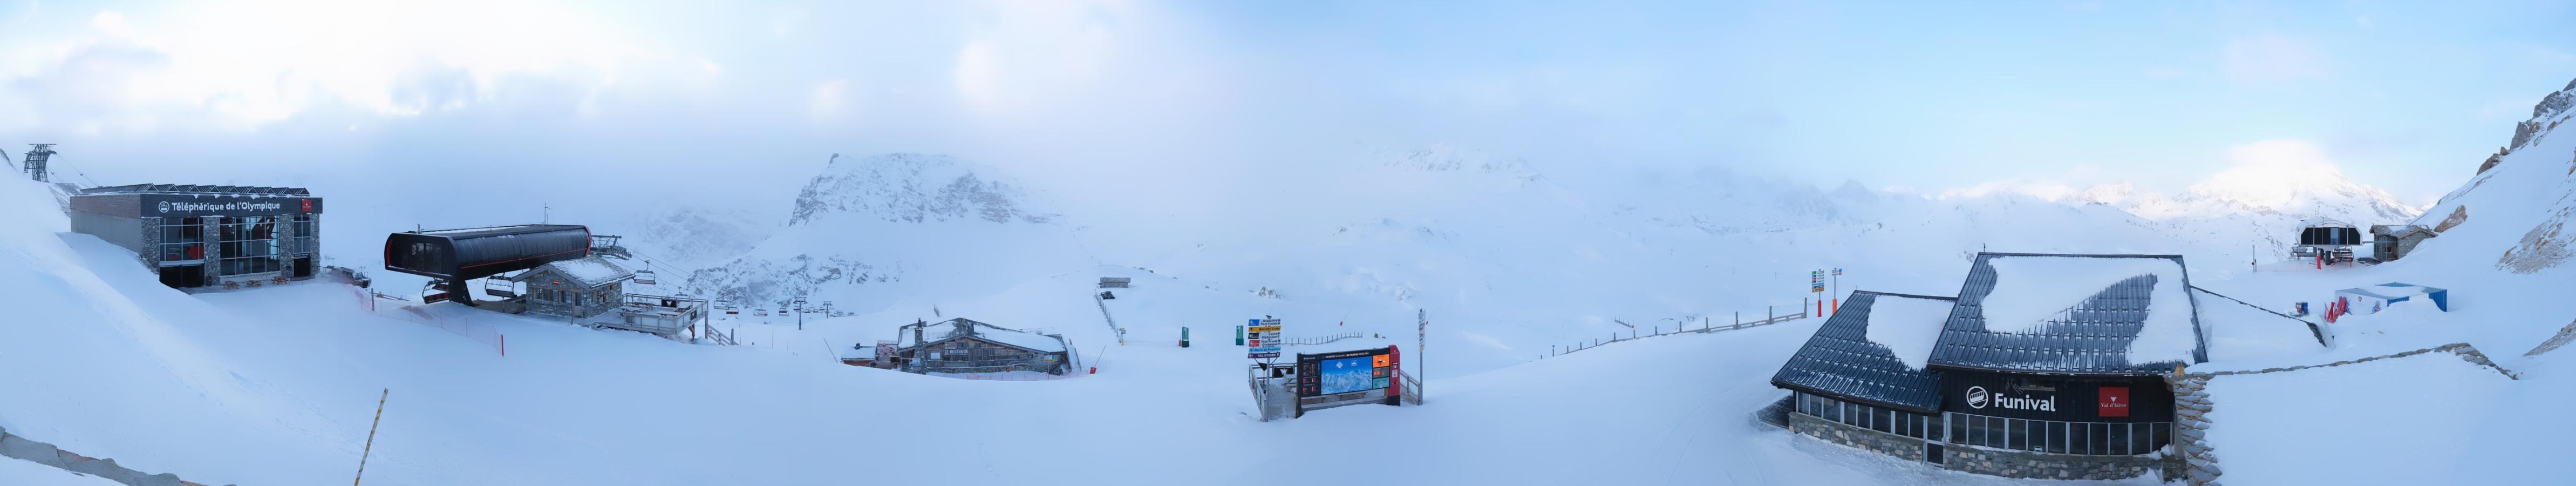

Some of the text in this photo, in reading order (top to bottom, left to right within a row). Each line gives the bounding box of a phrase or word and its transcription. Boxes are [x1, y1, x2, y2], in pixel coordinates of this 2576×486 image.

[172, 202, 224, 213] Téléphérique
[237, 201, 281, 211] l'Olympique
[1995, 393, 2056, 411] Funival
